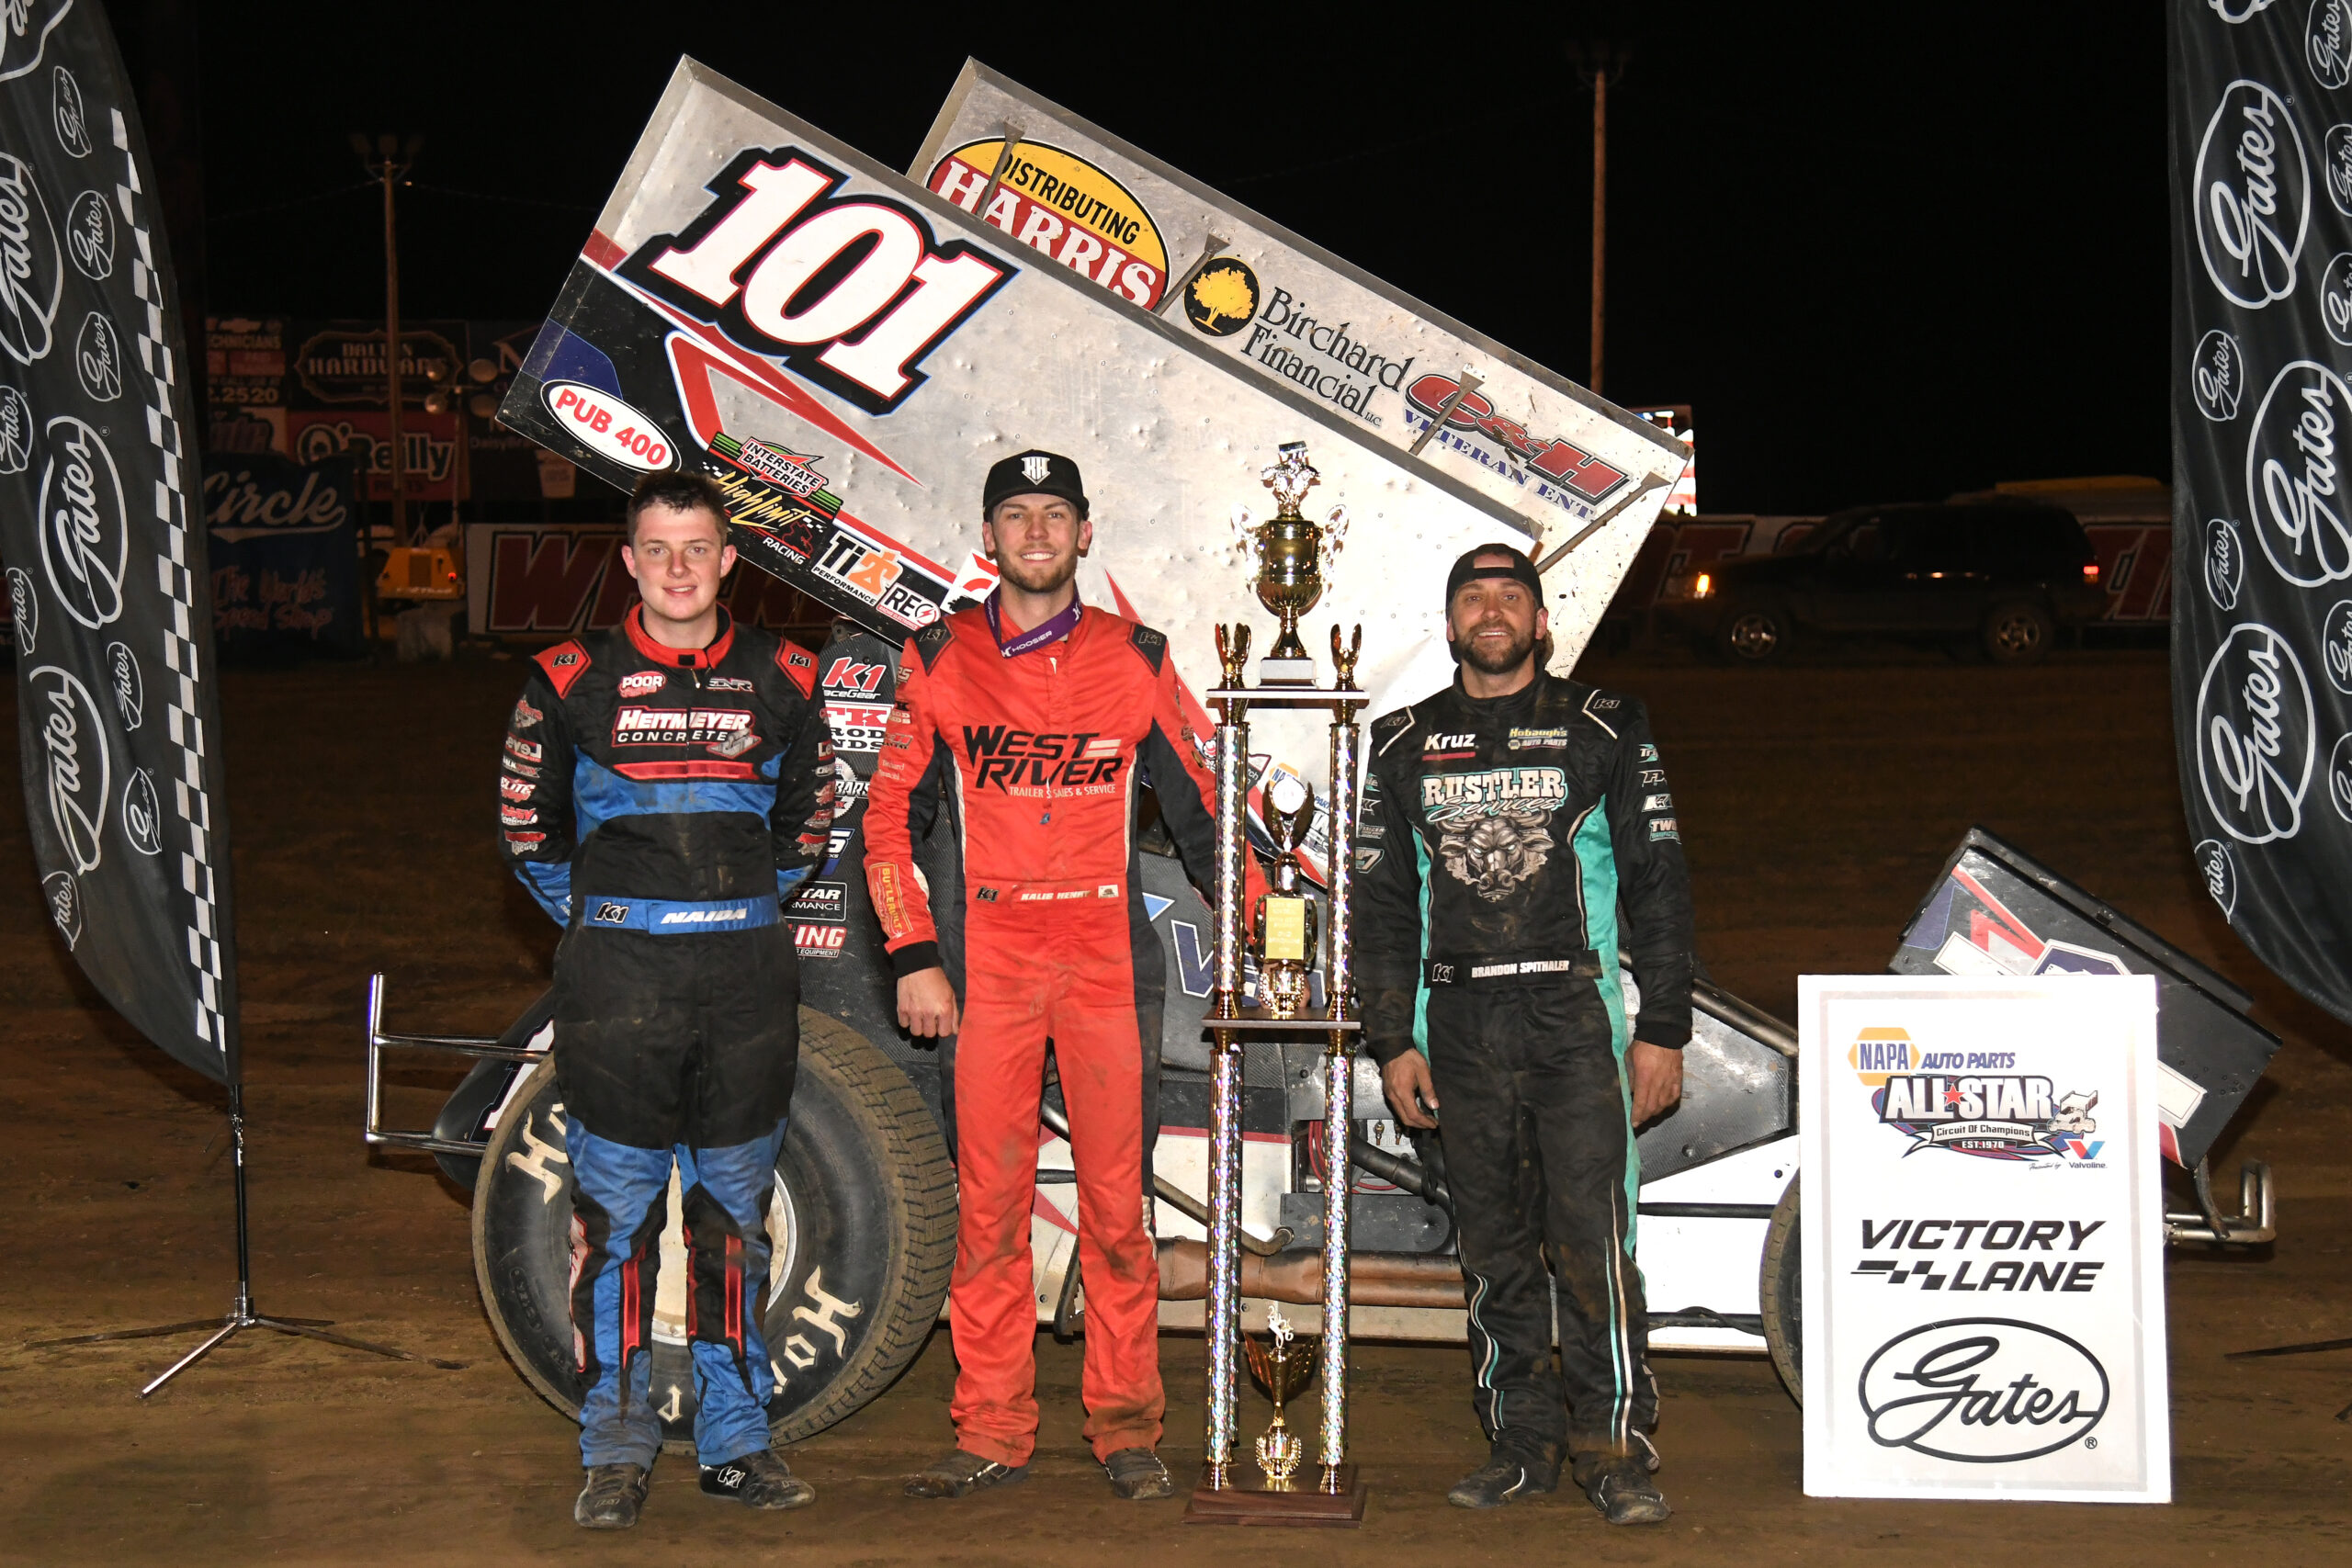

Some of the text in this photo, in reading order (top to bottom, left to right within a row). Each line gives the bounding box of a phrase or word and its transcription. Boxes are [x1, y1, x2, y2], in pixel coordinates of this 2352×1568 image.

[1001, 154, 1139, 245] DISTRIBUTING
[2211, 92, 2296, 300] Gates
[73, 196, 111, 278] Gates
[936, 160, 1156, 310] HARRIS
[648, 157, 1004, 401] 101
[1259, 287, 1415, 394] Birchard
[82, 318, 120, 400] Gates
[1240, 323, 1376, 418] Financial
[2199, 337, 2237, 420] Gates
[554, 388, 667, 467] PUB 400
[743, 453, 810, 495] BATTERIES
[746, 442, 820, 488] INTERSTATE
[2263, 369, 2352, 581] Gates
[203, 470, 347, 533] Circle
[763, 536, 807, 565] RACING
[2211, 525, 2236, 611] Gates
[813, 566, 876, 605] PERFORMANCE
[1012, 630, 1053, 652] HOOSIER
[622, 675, 663, 689] POOR
[822, 657, 887, 692] K1
[823, 689, 881, 700] aceGear
[616, 709, 751, 731] HEITMEYER
[616, 730, 729, 743] CONCRETE
[1509, 727, 1567, 739] Hobaugh's
[2211, 635, 2301, 839] Gates
[832, 739, 885, 750] NDS
[962, 725, 1101, 770] WEST
[1424, 733, 1476, 750] Kruz
[1521, 739, 1567, 747] AUTO PARTS
[974, 757, 1123, 795] RIVER
[1075, 787, 1082, 796] &
[1085, 784, 1116, 795] SERVICE
[1422, 769, 1565, 807] RUSTLER
[1427, 795, 1560, 822] Services
[594, 902, 630, 924] K1
[661, 908, 748, 925] NAIDA
[1471, 960, 1570, 978] BRANDON SPITHALER
[1860, 1043, 2016, 1070] NAPA AUTO PARTS
[1936, 1125, 1966, 1136] Circuit
[1980, 1124, 2030, 1136] Champions
[1962, 1140, 2005, 1149] EST.1970
[2069, 1161, 2106, 1169] Valvoline
[1861, 1219, 2106, 1250] VICTORY
[1947, 1261, 2105, 1292] LANE
[1868, 1336, 2100, 1448] Gates
